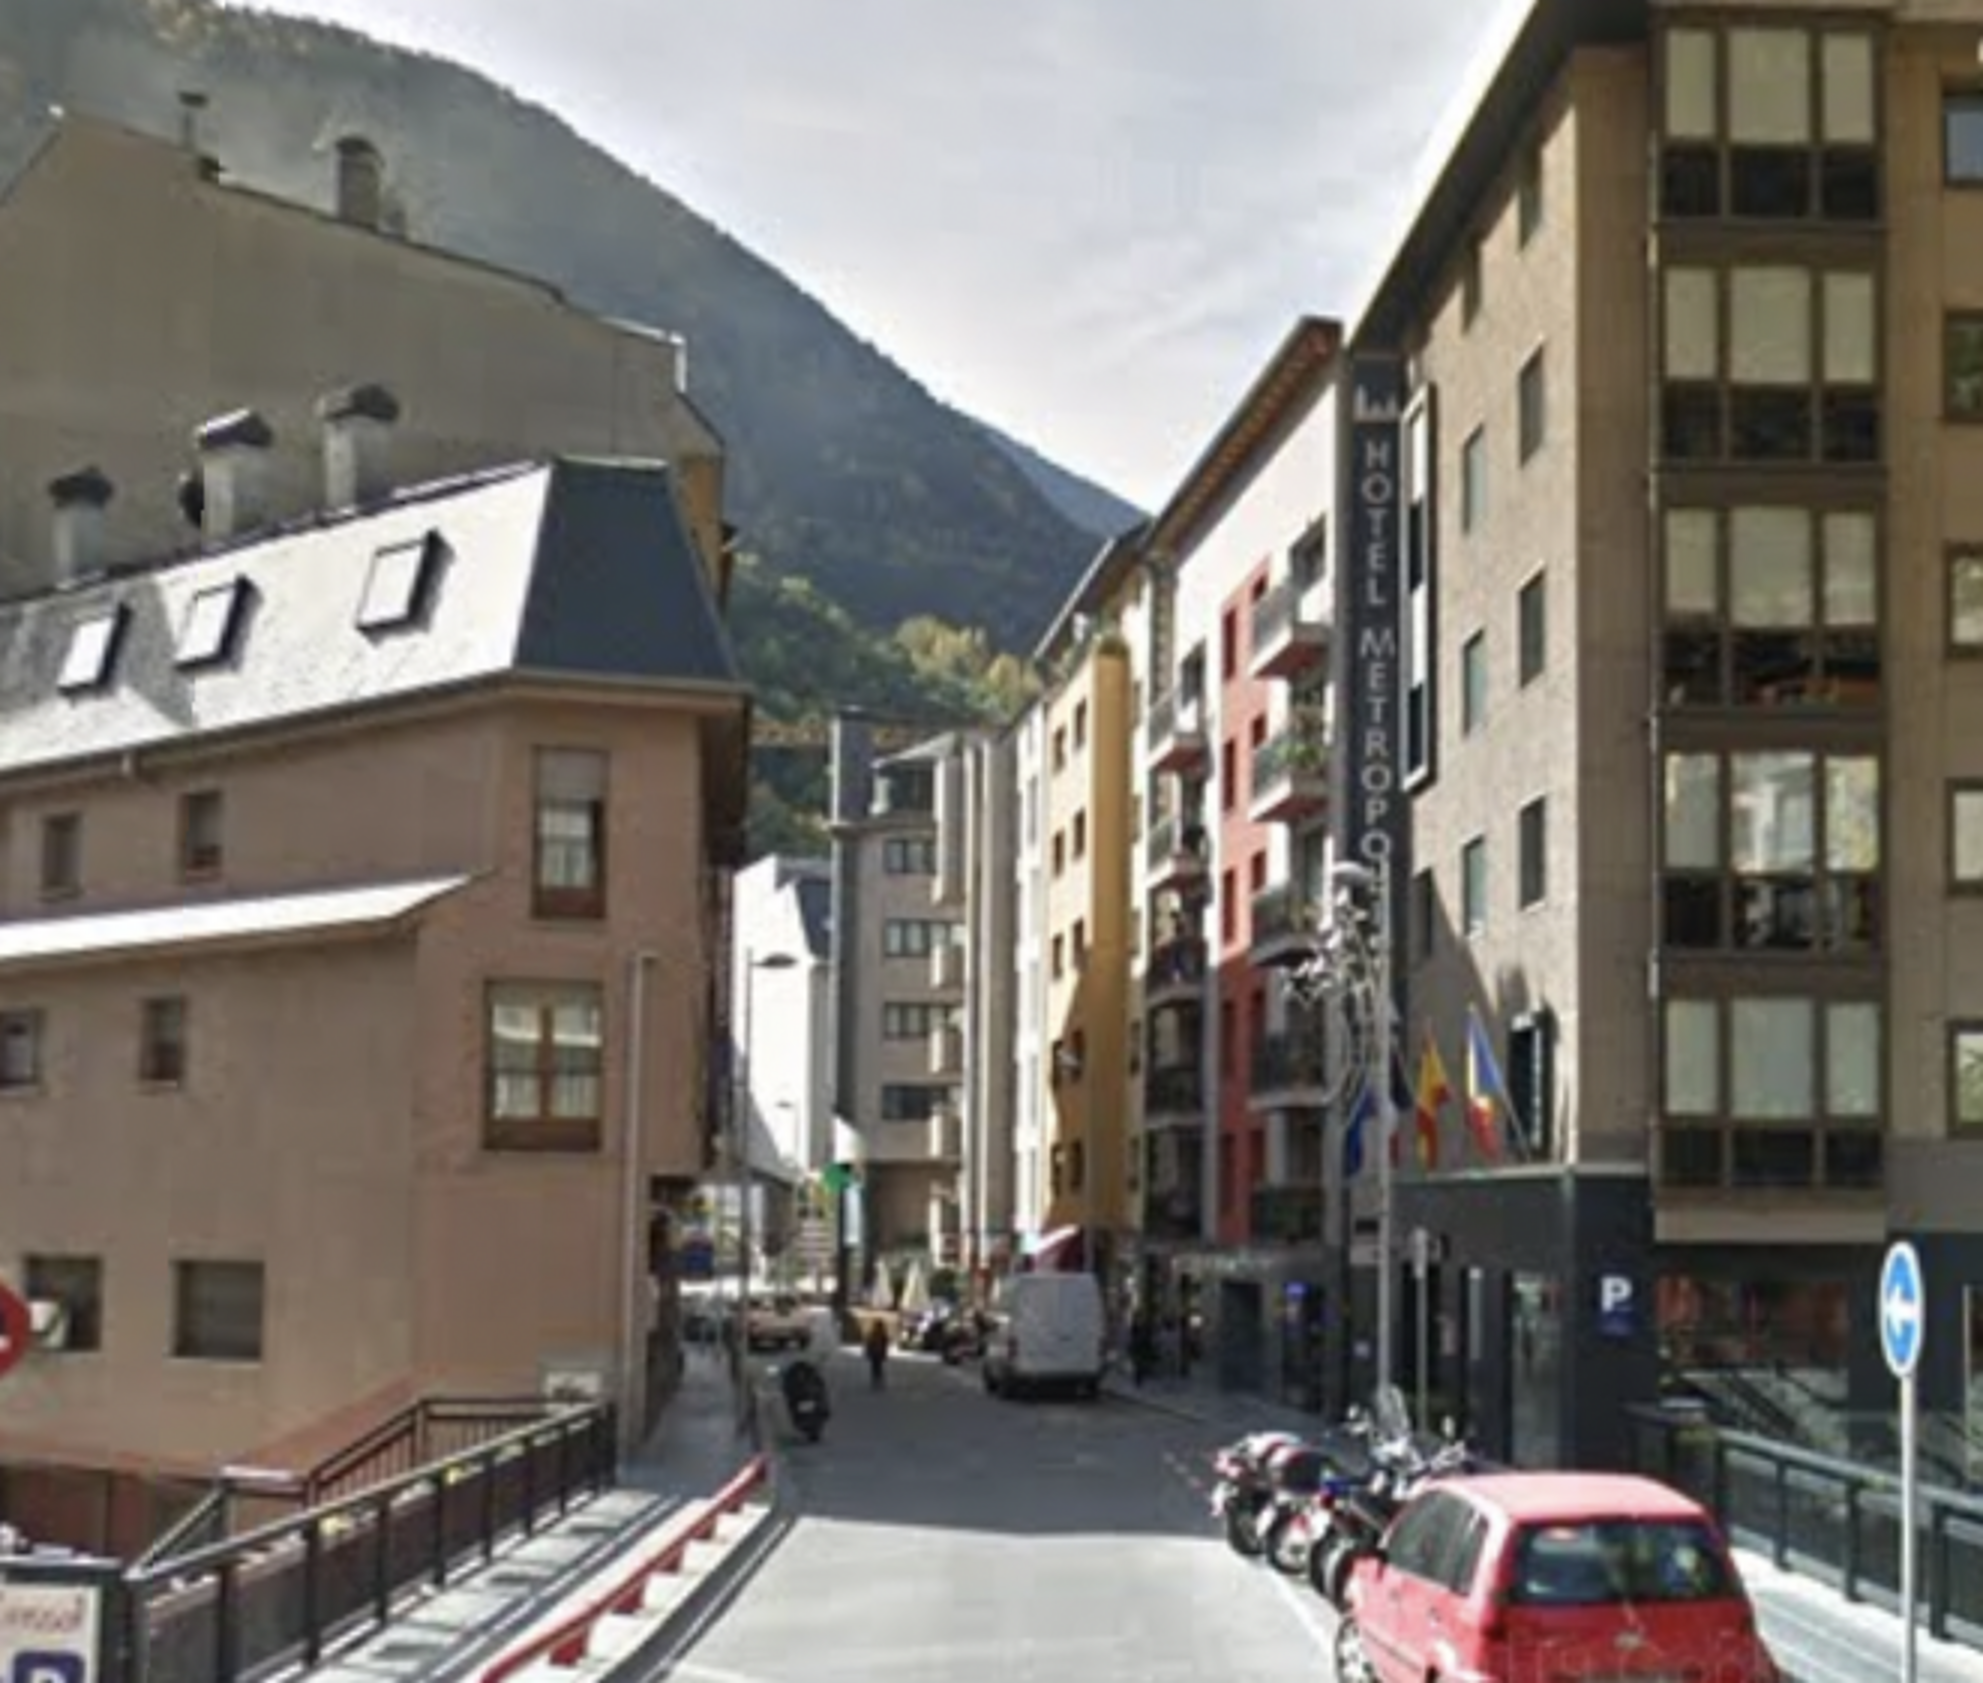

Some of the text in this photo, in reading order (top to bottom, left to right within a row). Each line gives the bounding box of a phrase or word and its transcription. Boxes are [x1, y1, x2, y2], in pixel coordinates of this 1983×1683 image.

[1360, 439, 1395, 864] HOTEL METROPO
[1601, 1276, 1633, 1312] P
